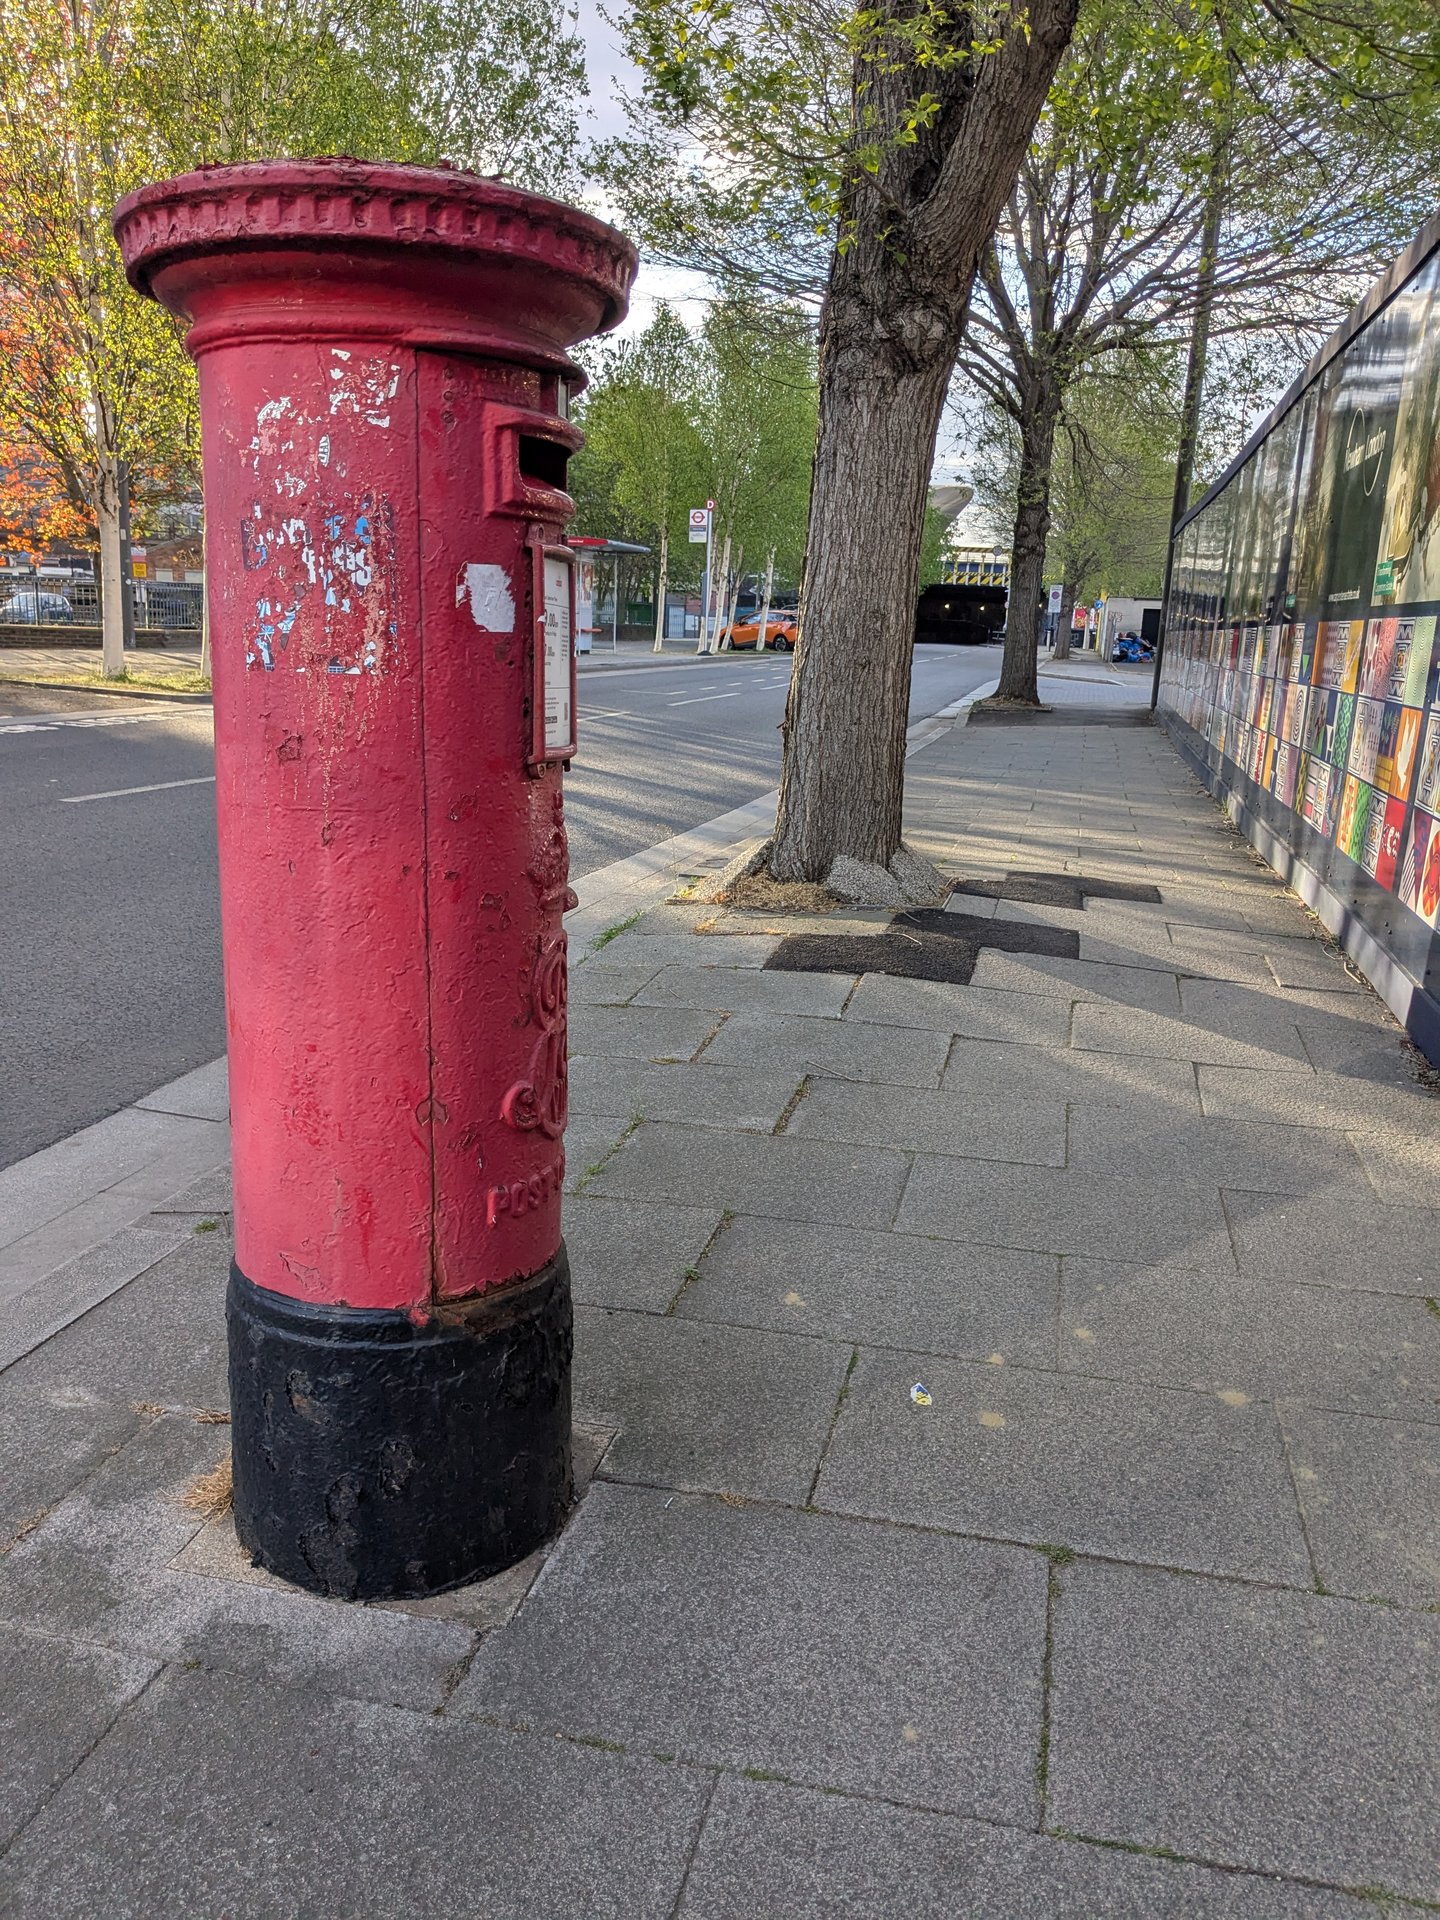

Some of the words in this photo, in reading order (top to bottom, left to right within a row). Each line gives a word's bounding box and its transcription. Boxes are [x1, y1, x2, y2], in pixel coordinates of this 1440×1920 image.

[1364, 426, 1387, 461] London
[707, 500, 715, 509] D
[486, 1164, 553, 1228] POST
